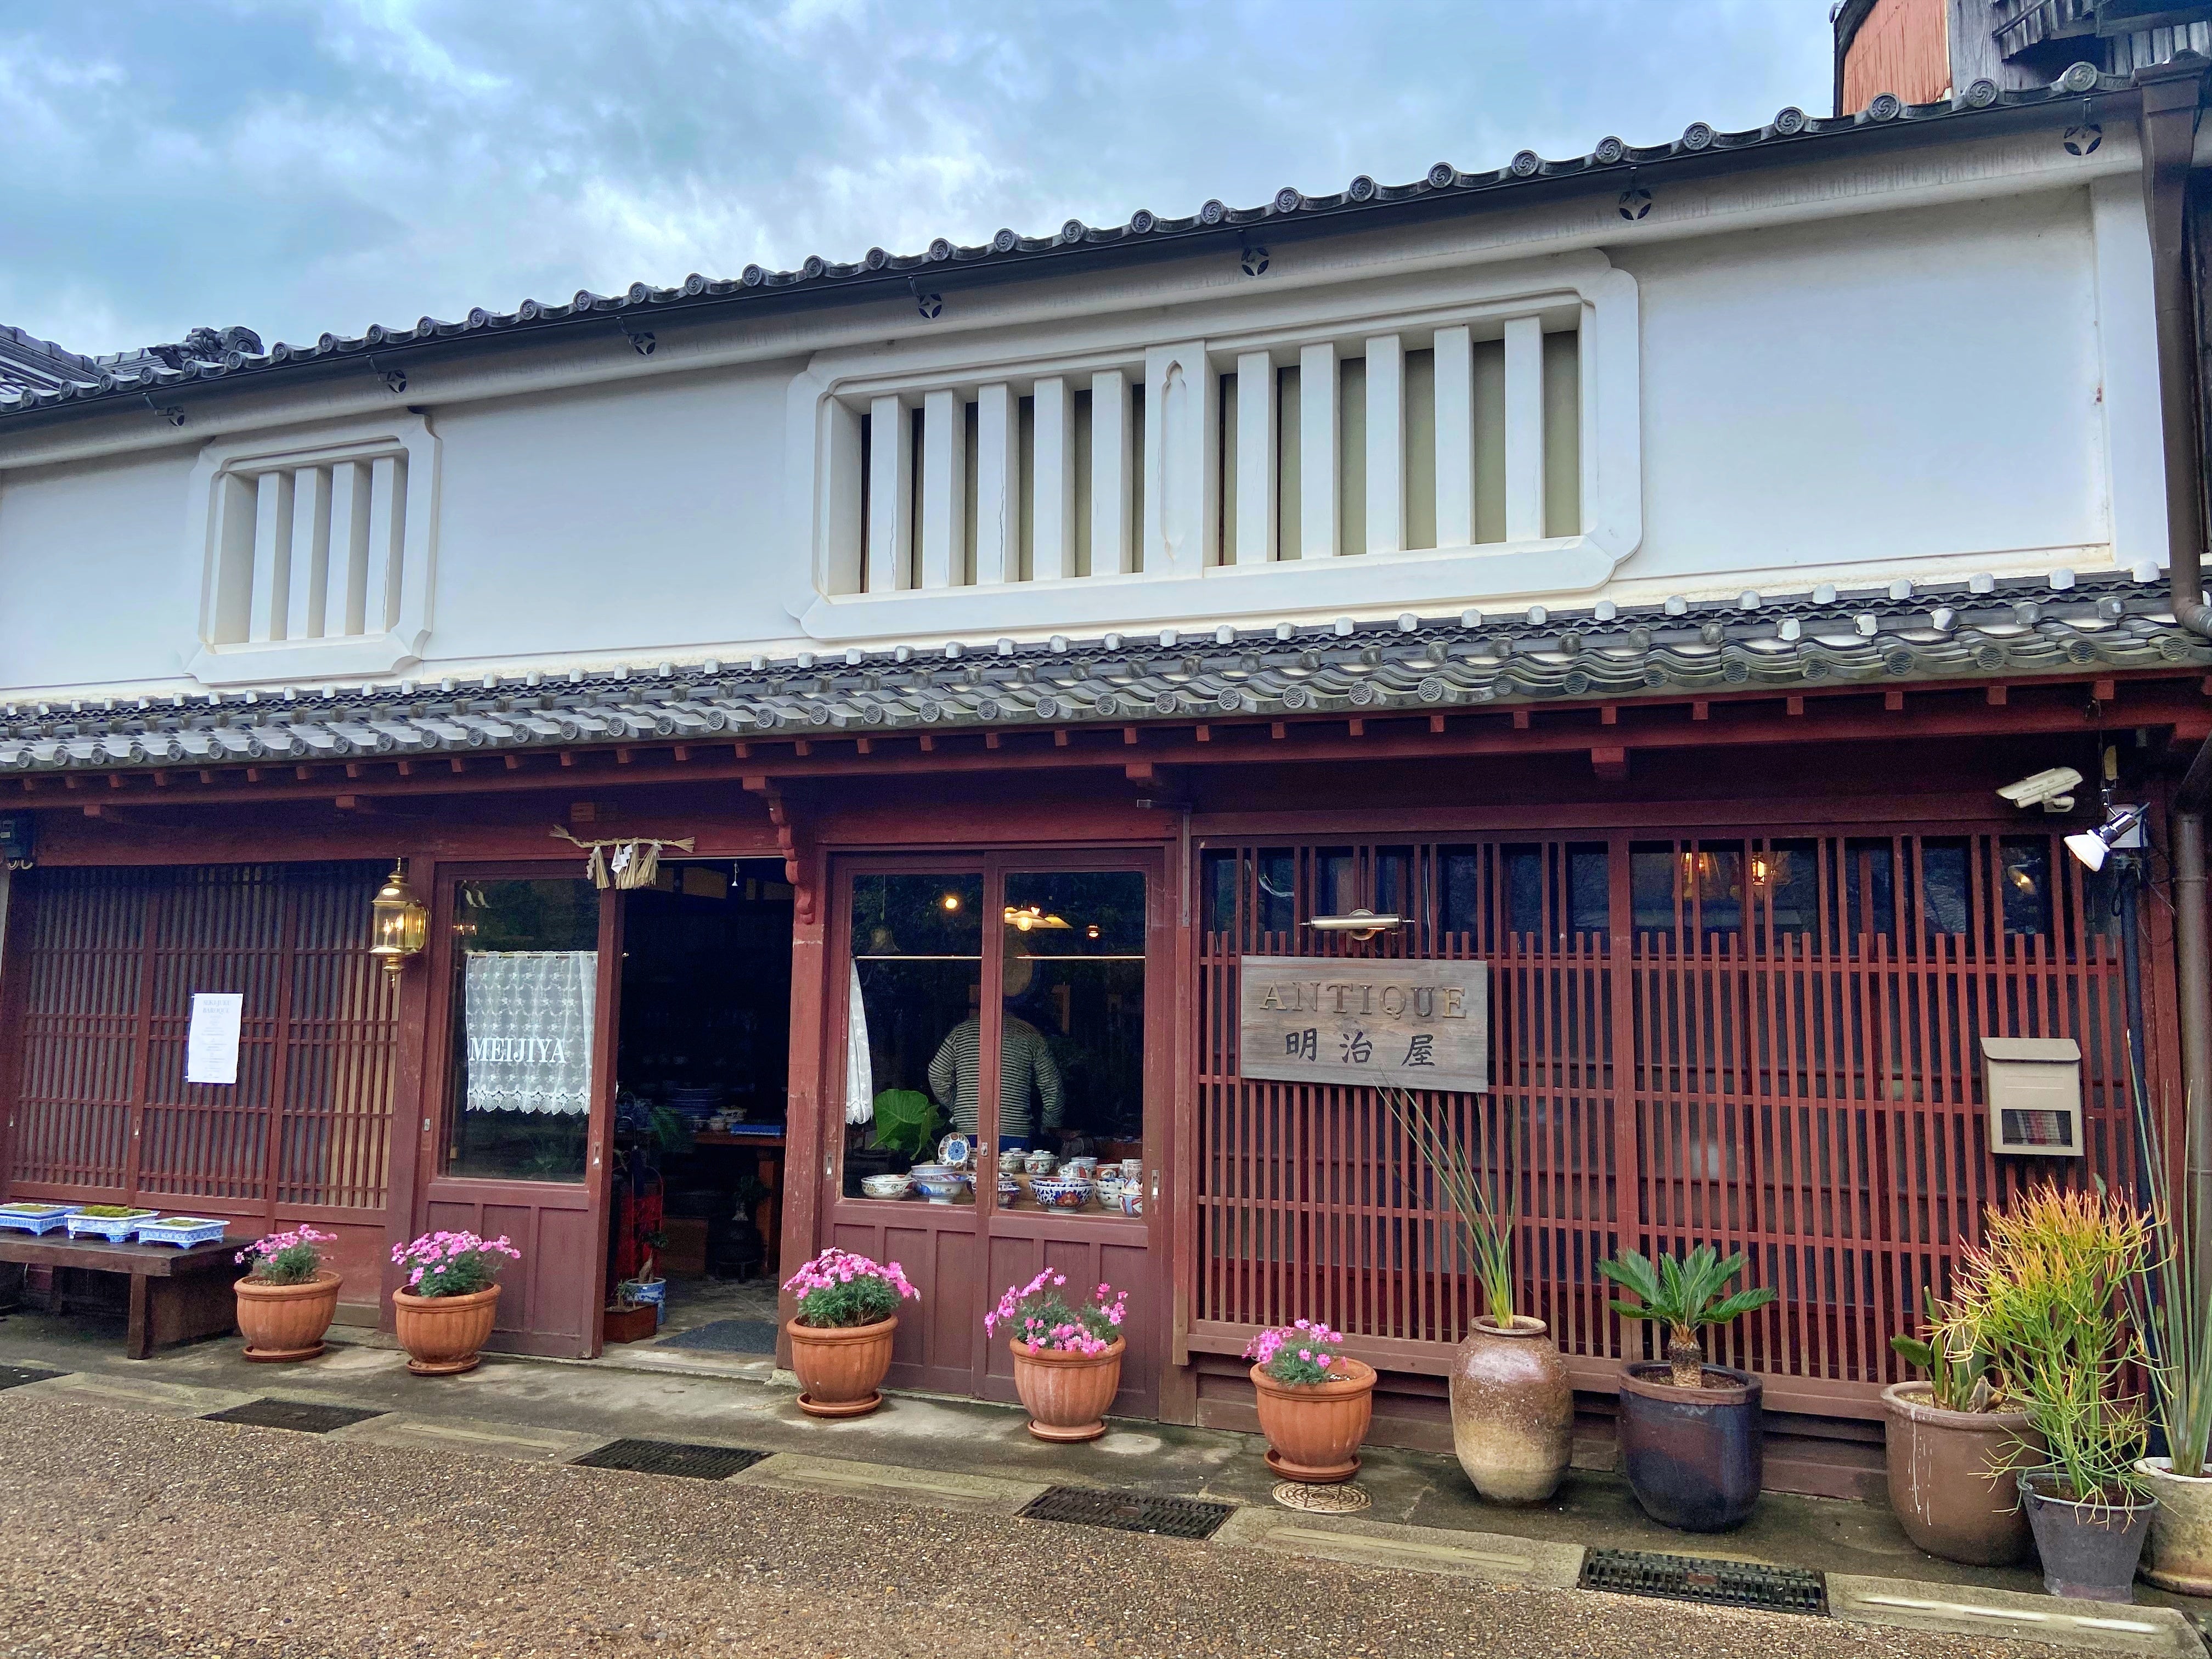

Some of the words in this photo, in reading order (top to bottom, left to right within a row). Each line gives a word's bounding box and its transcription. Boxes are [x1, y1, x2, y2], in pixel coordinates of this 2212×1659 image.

[1260, 980, 1467, 1019] ANTIQUE
[469, 1037, 566, 1063] MEIJIYA
[1285, 1028, 1436, 1067] 明治屋
